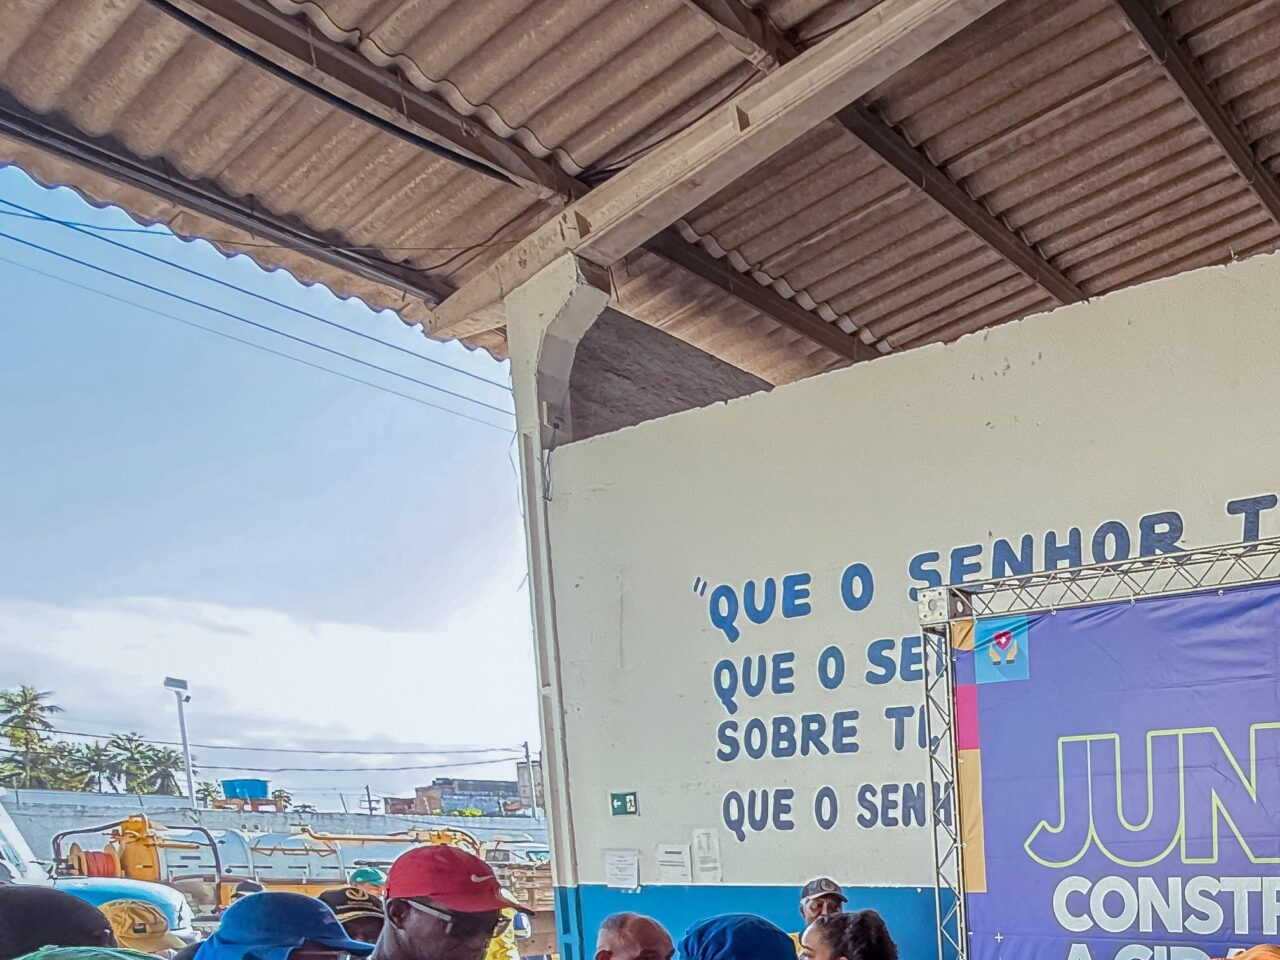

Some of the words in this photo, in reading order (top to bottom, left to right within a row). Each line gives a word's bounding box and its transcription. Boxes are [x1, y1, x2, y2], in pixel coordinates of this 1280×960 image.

[841, 563, 874, 611] O
[909, 510, 1191, 602] SENHOR
[714, 652, 795, 714] QUE
[818, 645, 845, 690] O
[717, 710, 859, 761] SOBRE
[722, 788, 795, 842] QUE
[814, 786, 838, 830] O
